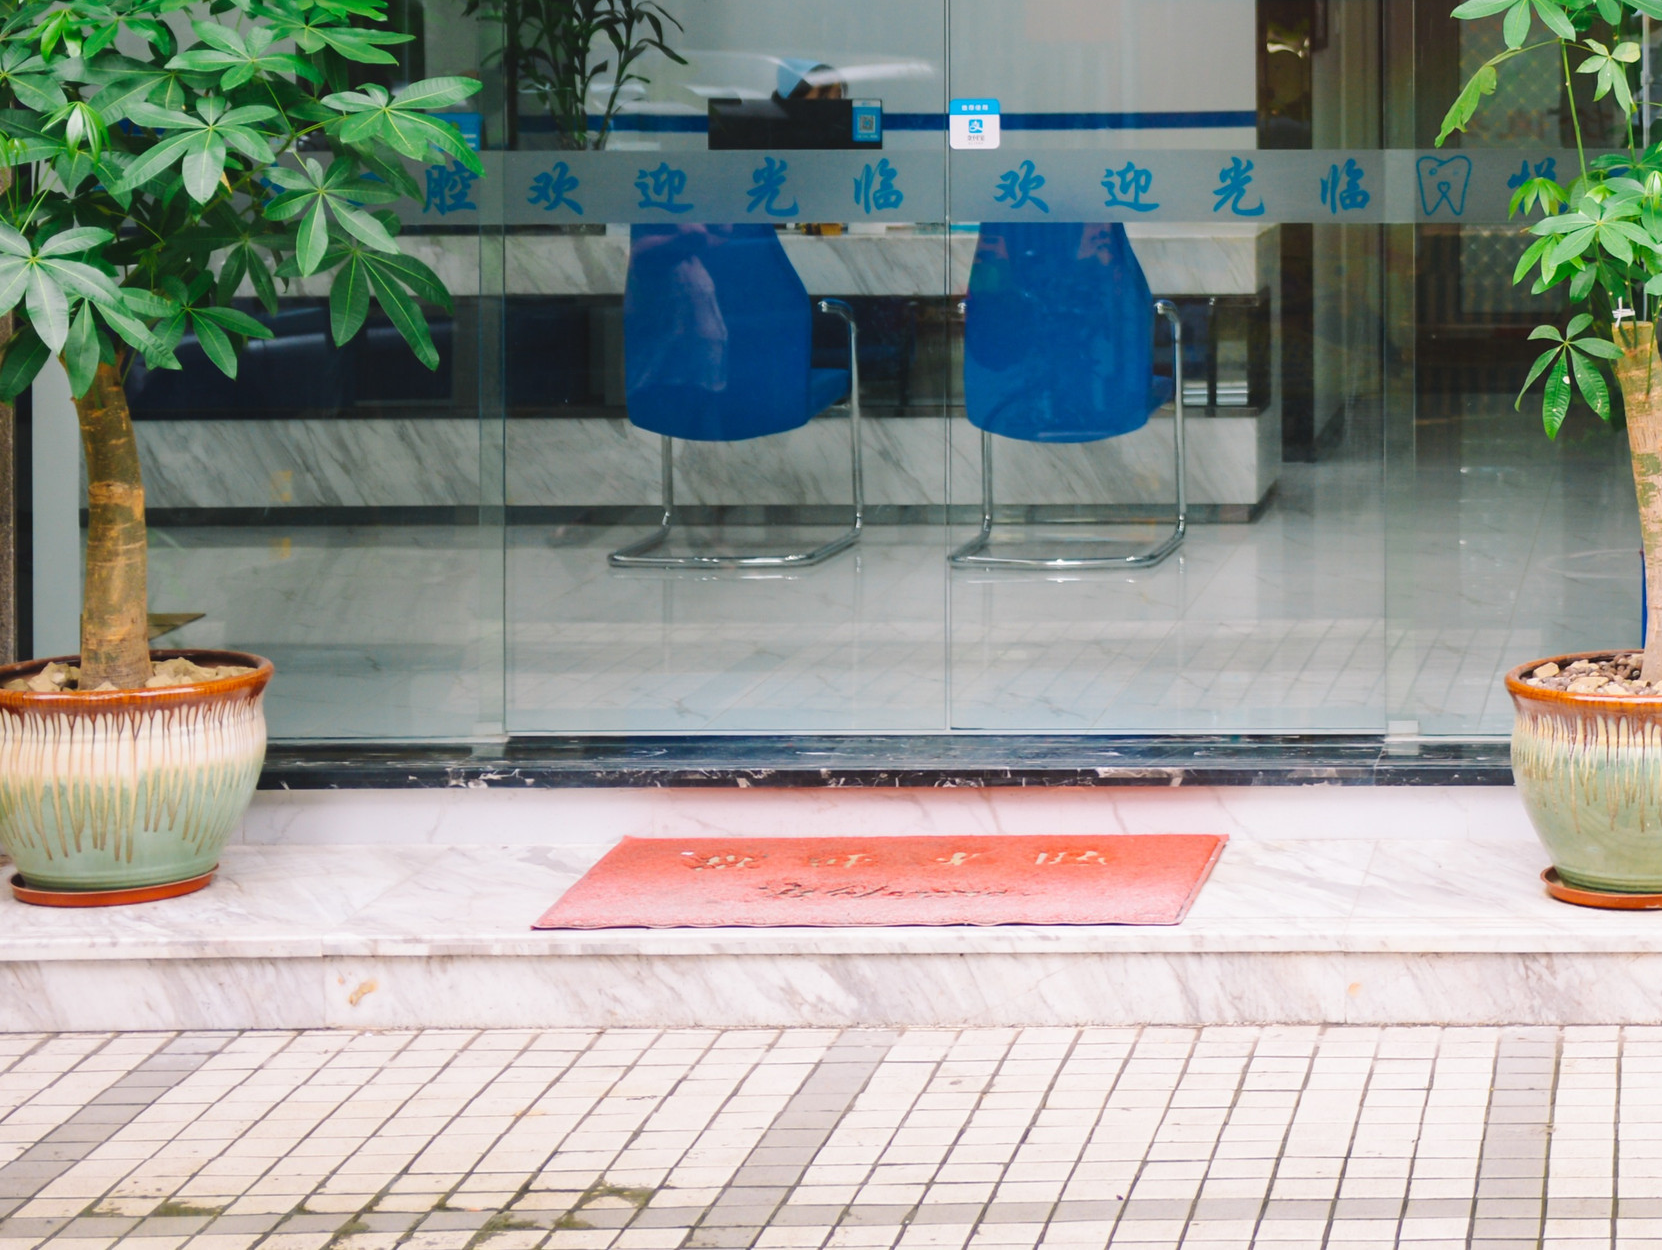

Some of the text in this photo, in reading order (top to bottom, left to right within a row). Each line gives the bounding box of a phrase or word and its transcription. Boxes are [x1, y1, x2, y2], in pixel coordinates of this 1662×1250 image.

[527, 156, 904, 217] 欢迎光临
[992, 156, 1371, 217] 欢迎光临
